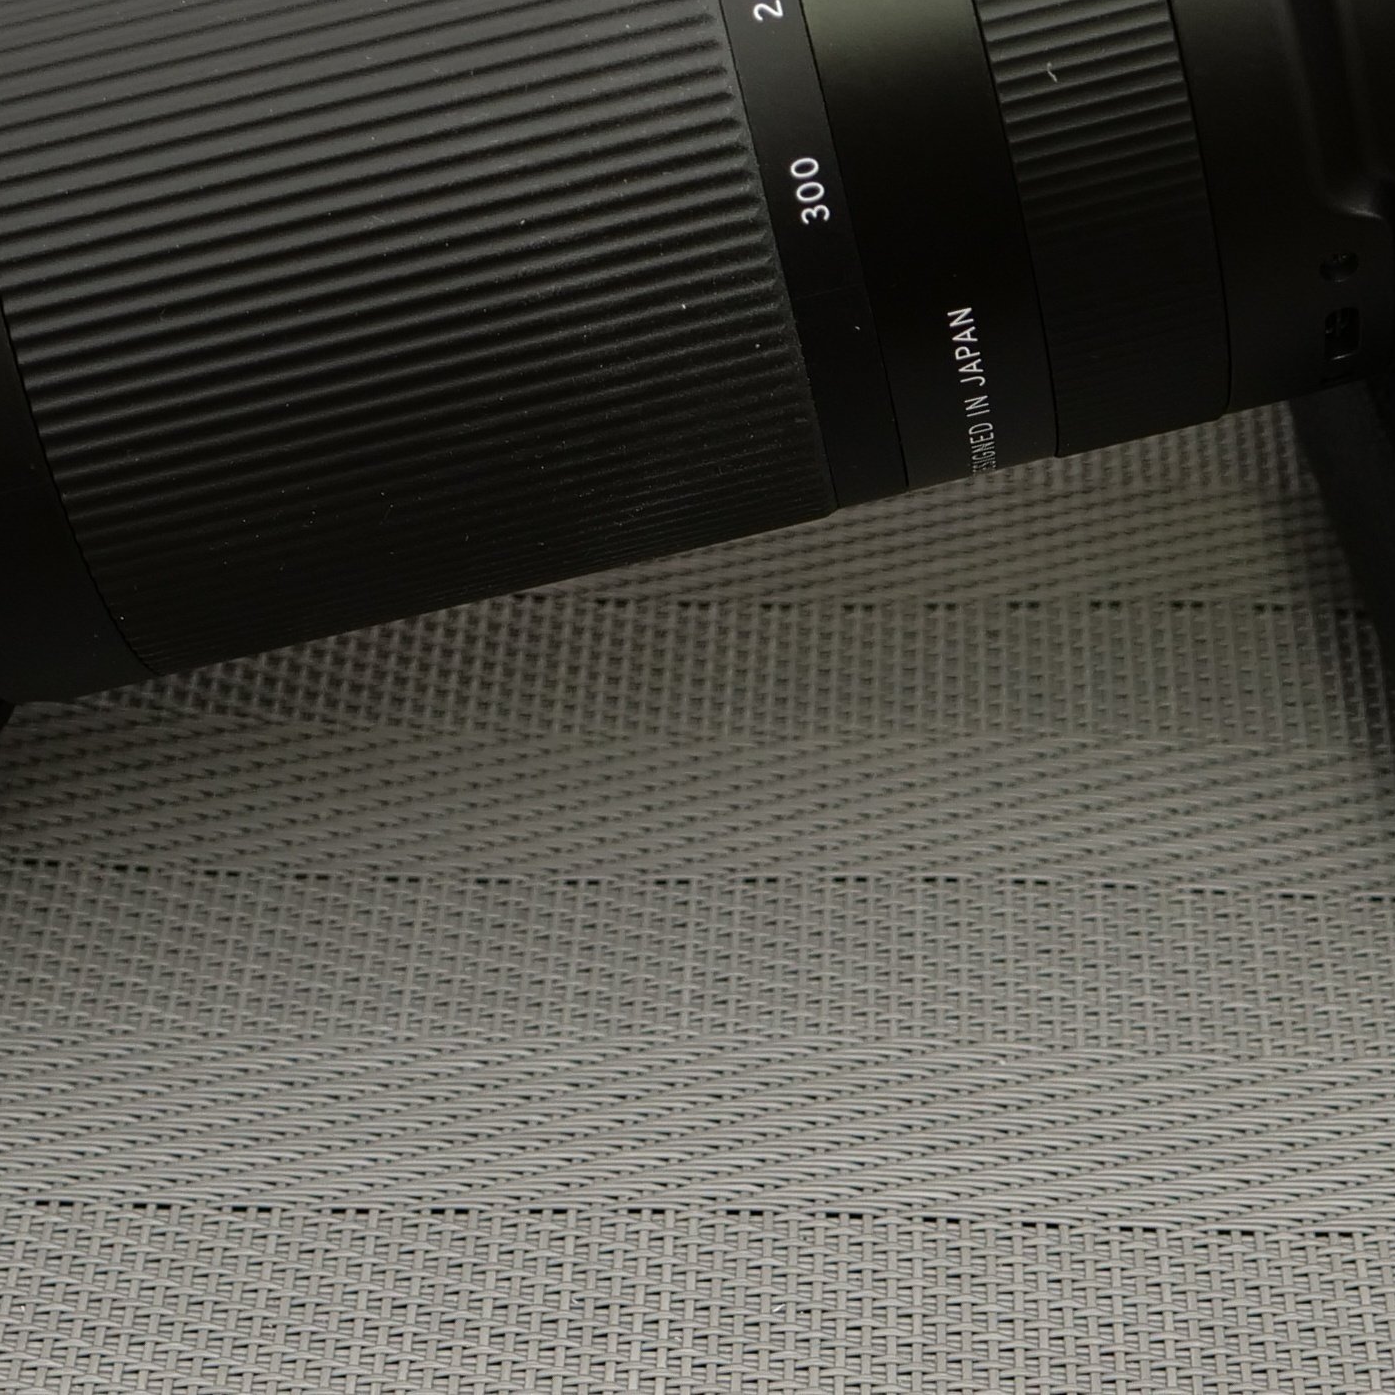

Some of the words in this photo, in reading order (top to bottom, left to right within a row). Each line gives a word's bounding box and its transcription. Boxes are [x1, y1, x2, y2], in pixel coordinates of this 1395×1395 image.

[790, 156, 831, 226] 300
[946, 306, 987, 387] JAPAN
[964, 394, 991, 418] IN
